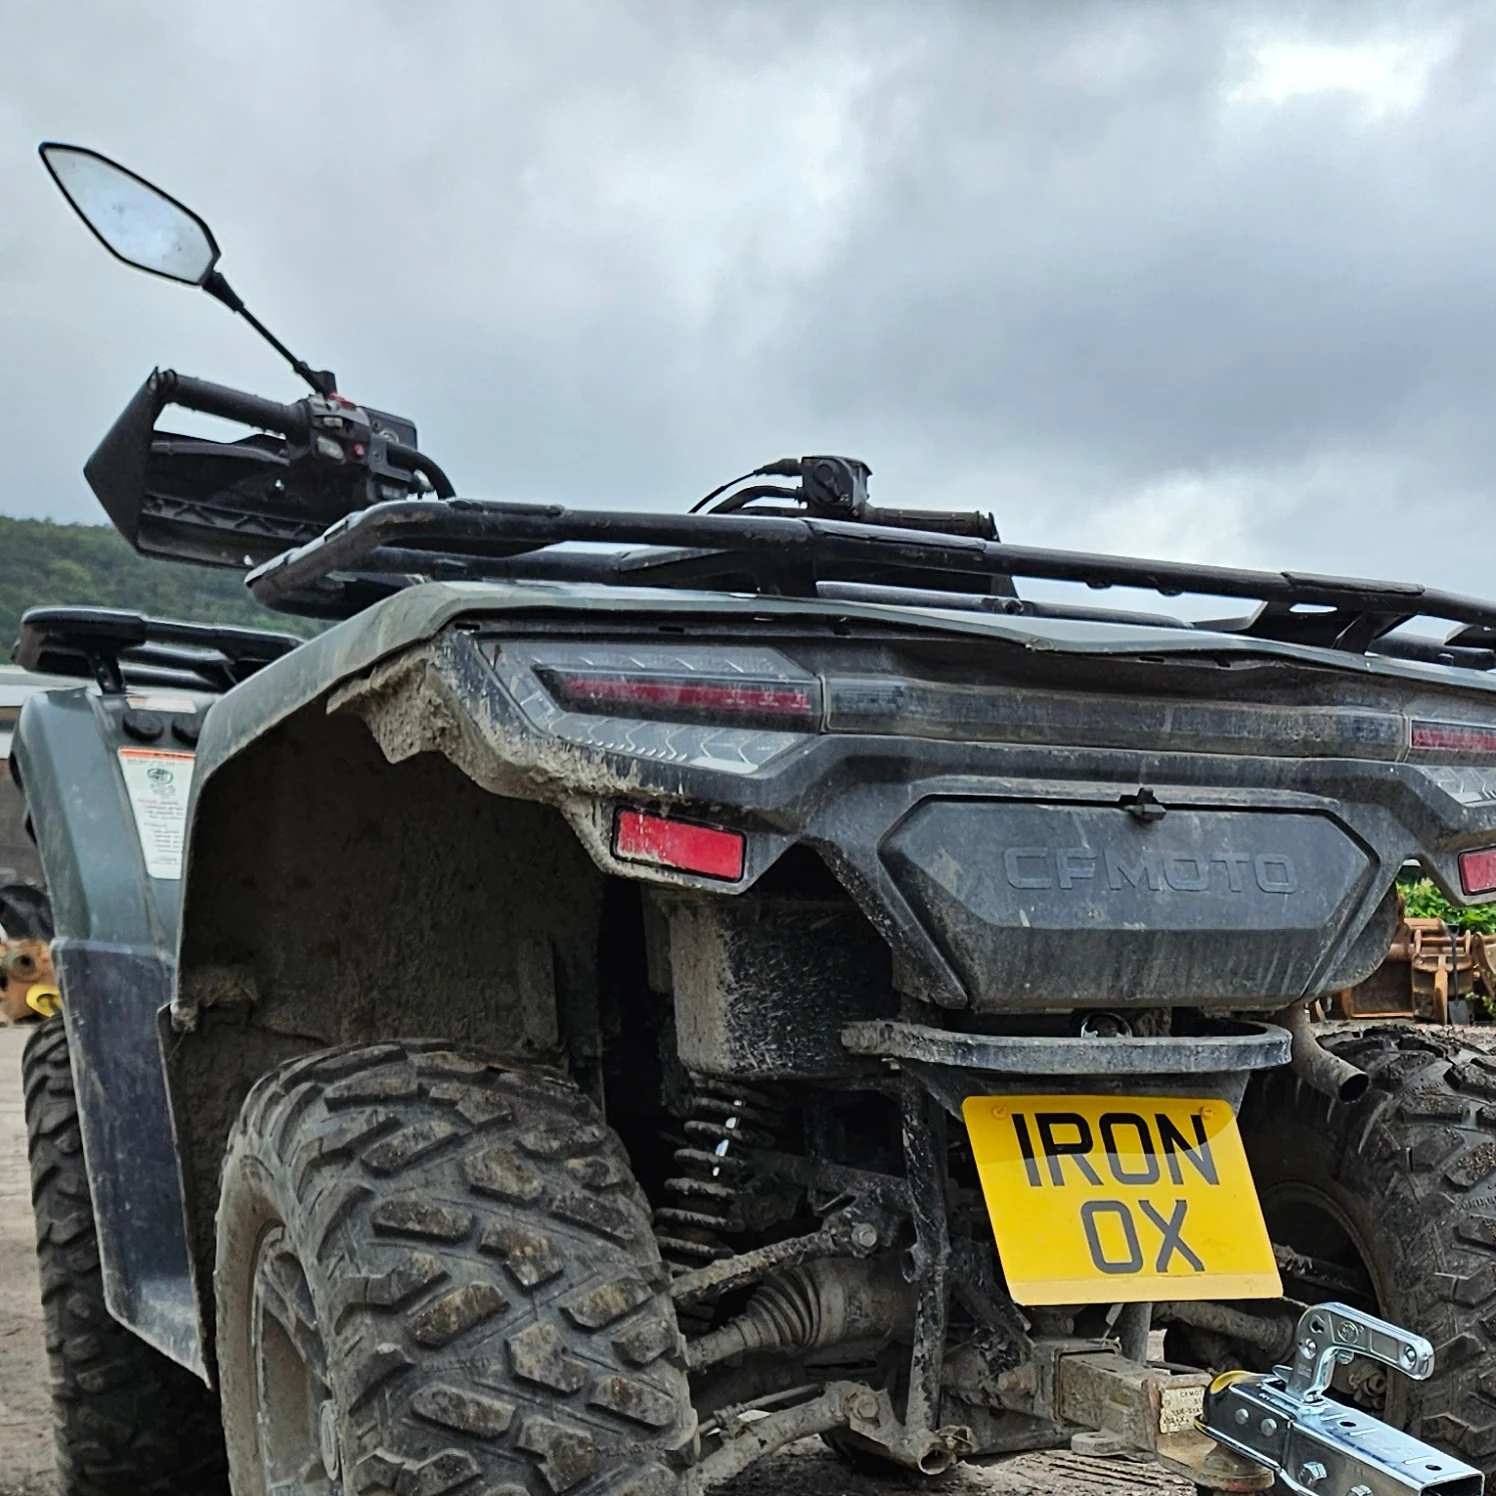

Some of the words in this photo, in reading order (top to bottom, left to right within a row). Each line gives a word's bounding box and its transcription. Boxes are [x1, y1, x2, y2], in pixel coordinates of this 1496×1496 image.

[1003, 847, 1297, 894] CFMOTO
[1011, 1112, 1220, 1187] IRON
[1080, 1200, 1205, 1275] OX
